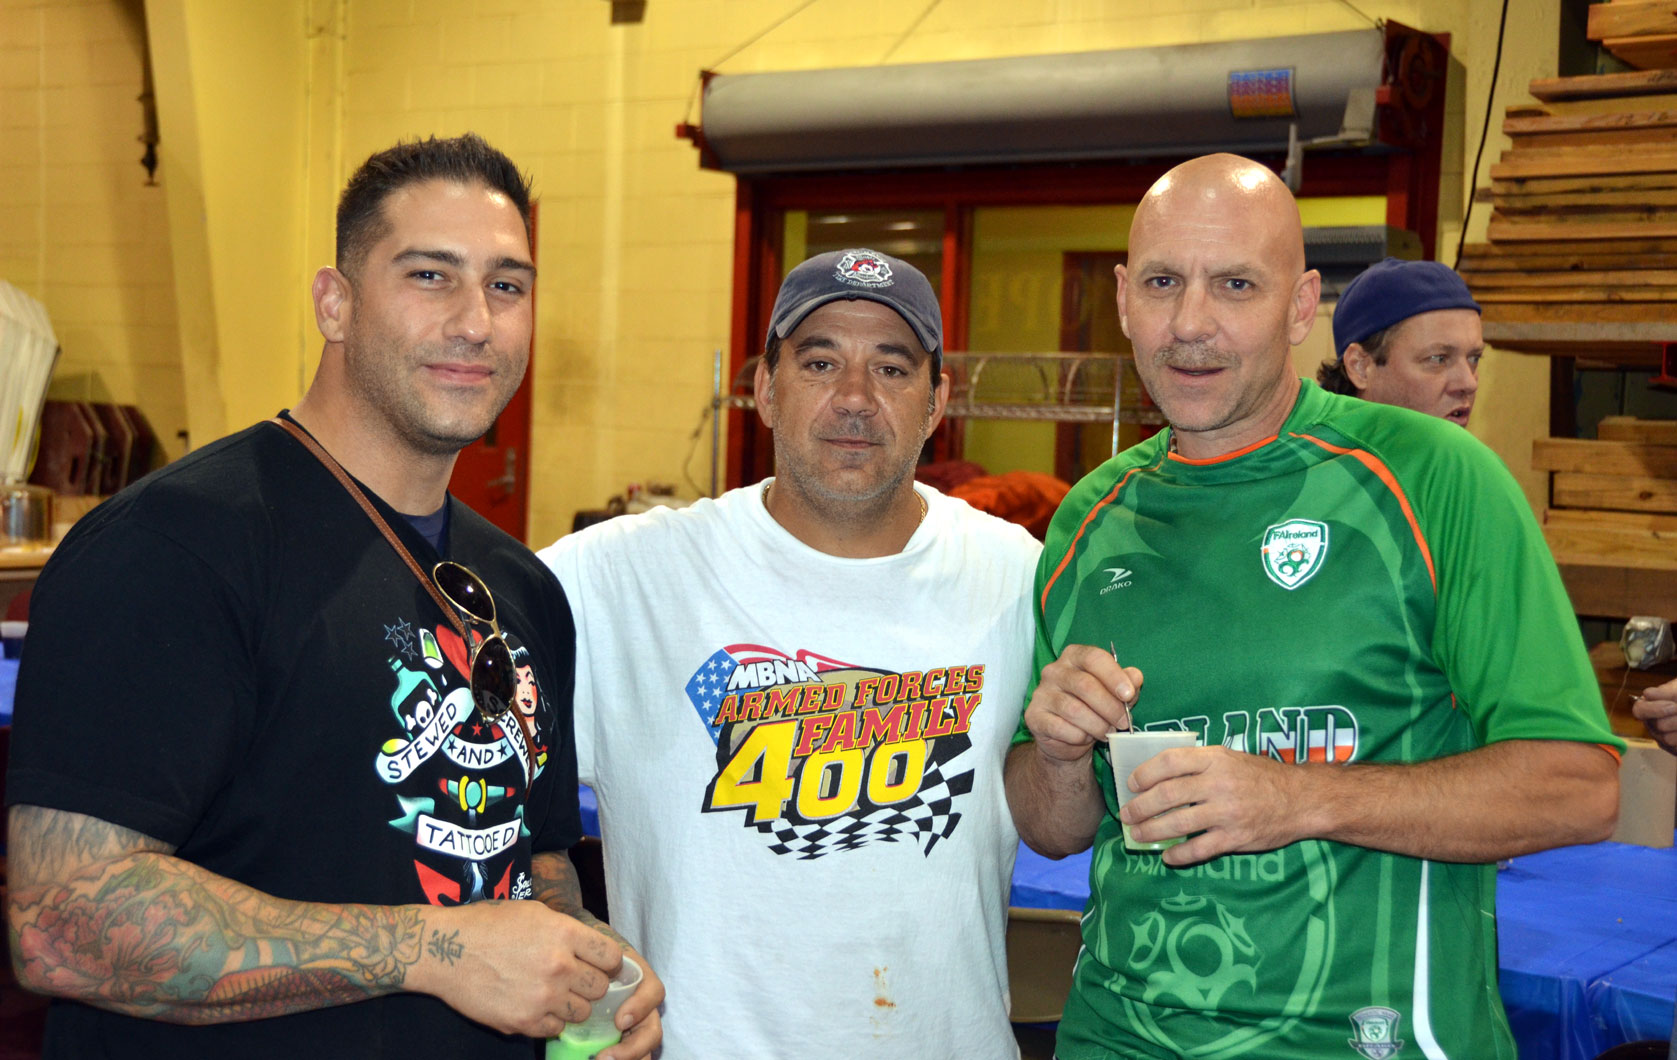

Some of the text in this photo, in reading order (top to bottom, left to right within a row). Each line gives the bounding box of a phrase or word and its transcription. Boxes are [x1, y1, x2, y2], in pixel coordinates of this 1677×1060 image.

[1099, 581, 1132, 596] DRAKO
[712, 664, 986, 728] ARMED FORCES
[725, 659, 824, 692] MBNA
[386, 702, 457, 780] STEWED
[793, 693, 983, 757] FAMILY
[457, 744, 494, 765] AND
[704, 719, 928, 824] 400
[425, 822, 515, 852] TATTOOED
